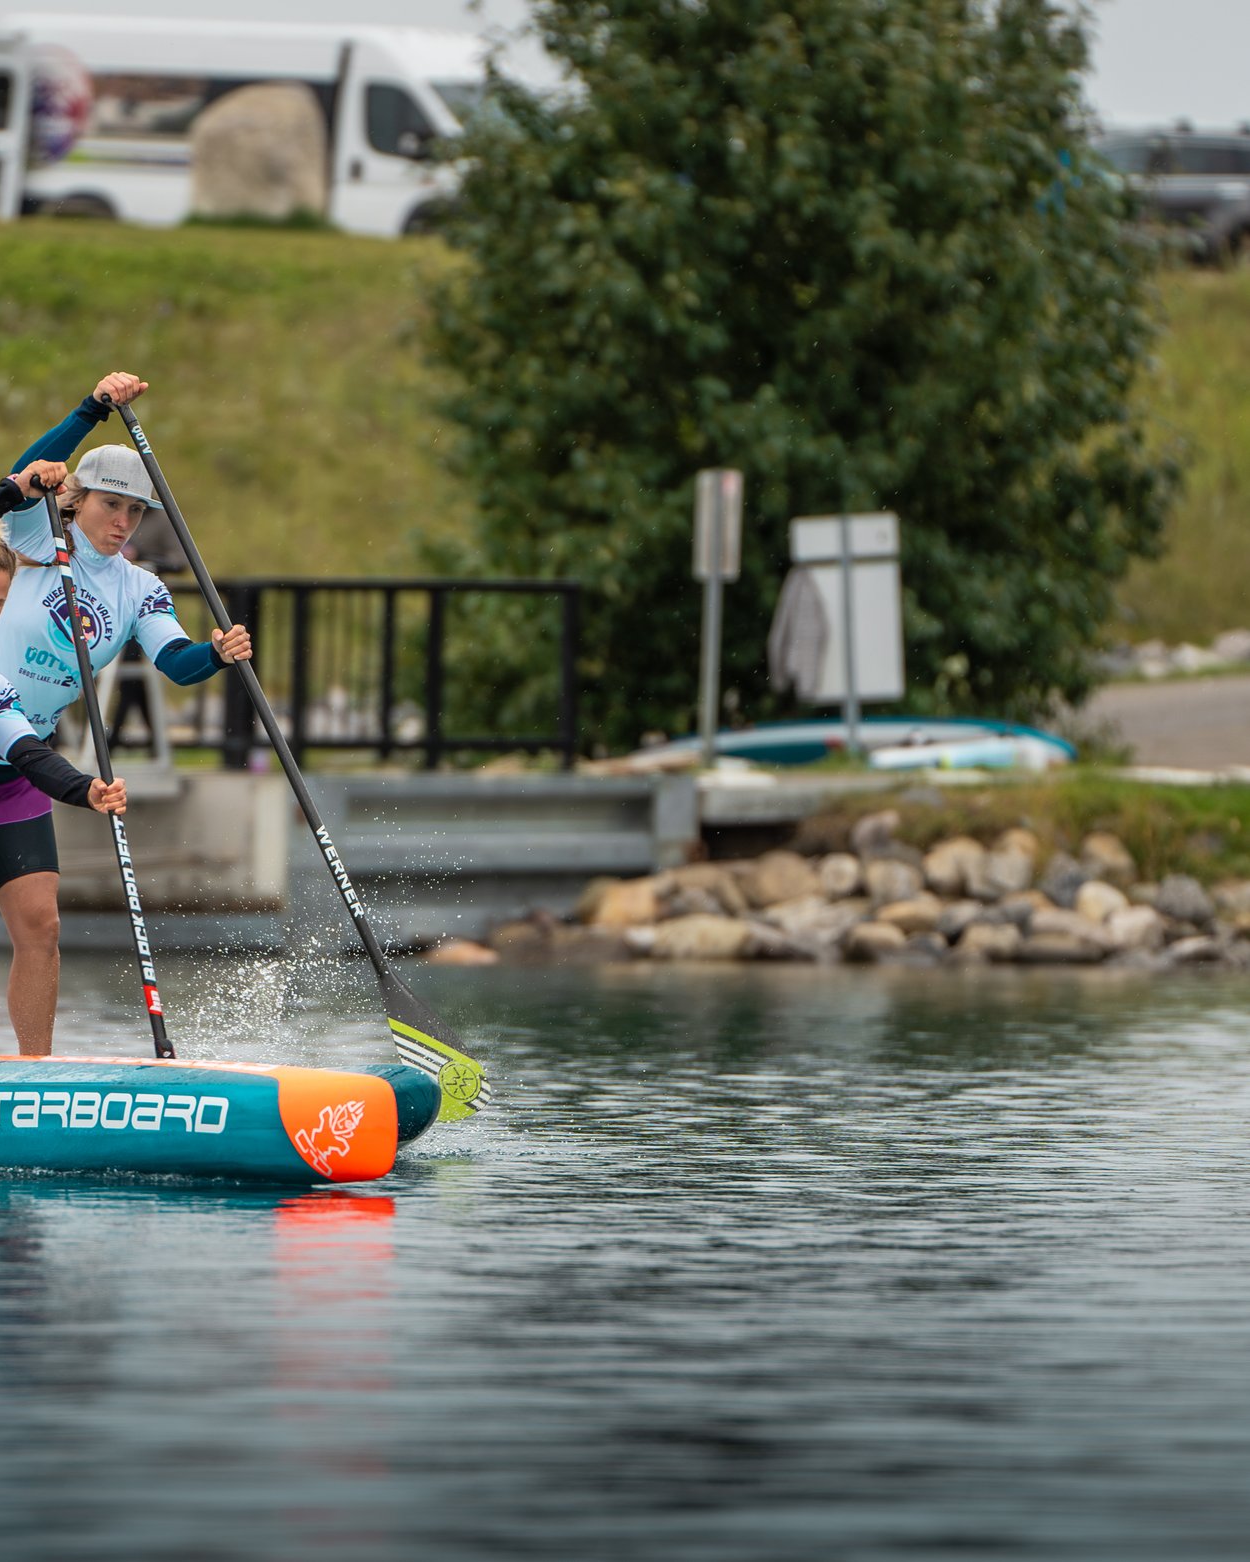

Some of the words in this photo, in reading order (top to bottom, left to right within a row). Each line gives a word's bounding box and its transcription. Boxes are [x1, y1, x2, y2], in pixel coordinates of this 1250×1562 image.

[131, 425, 153, 455] QOTV
[42, 586, 65, 608] QUEE
[80, 588, 97, 605] THE
[95, 603, 114, 642] VALLEY
[18, 667, 36, 680] GHOST
[112, 814, 142, 912] PROJECT
[316, 824, 365, 918] WERNER
[131, 913, 157, 983] BLACK
